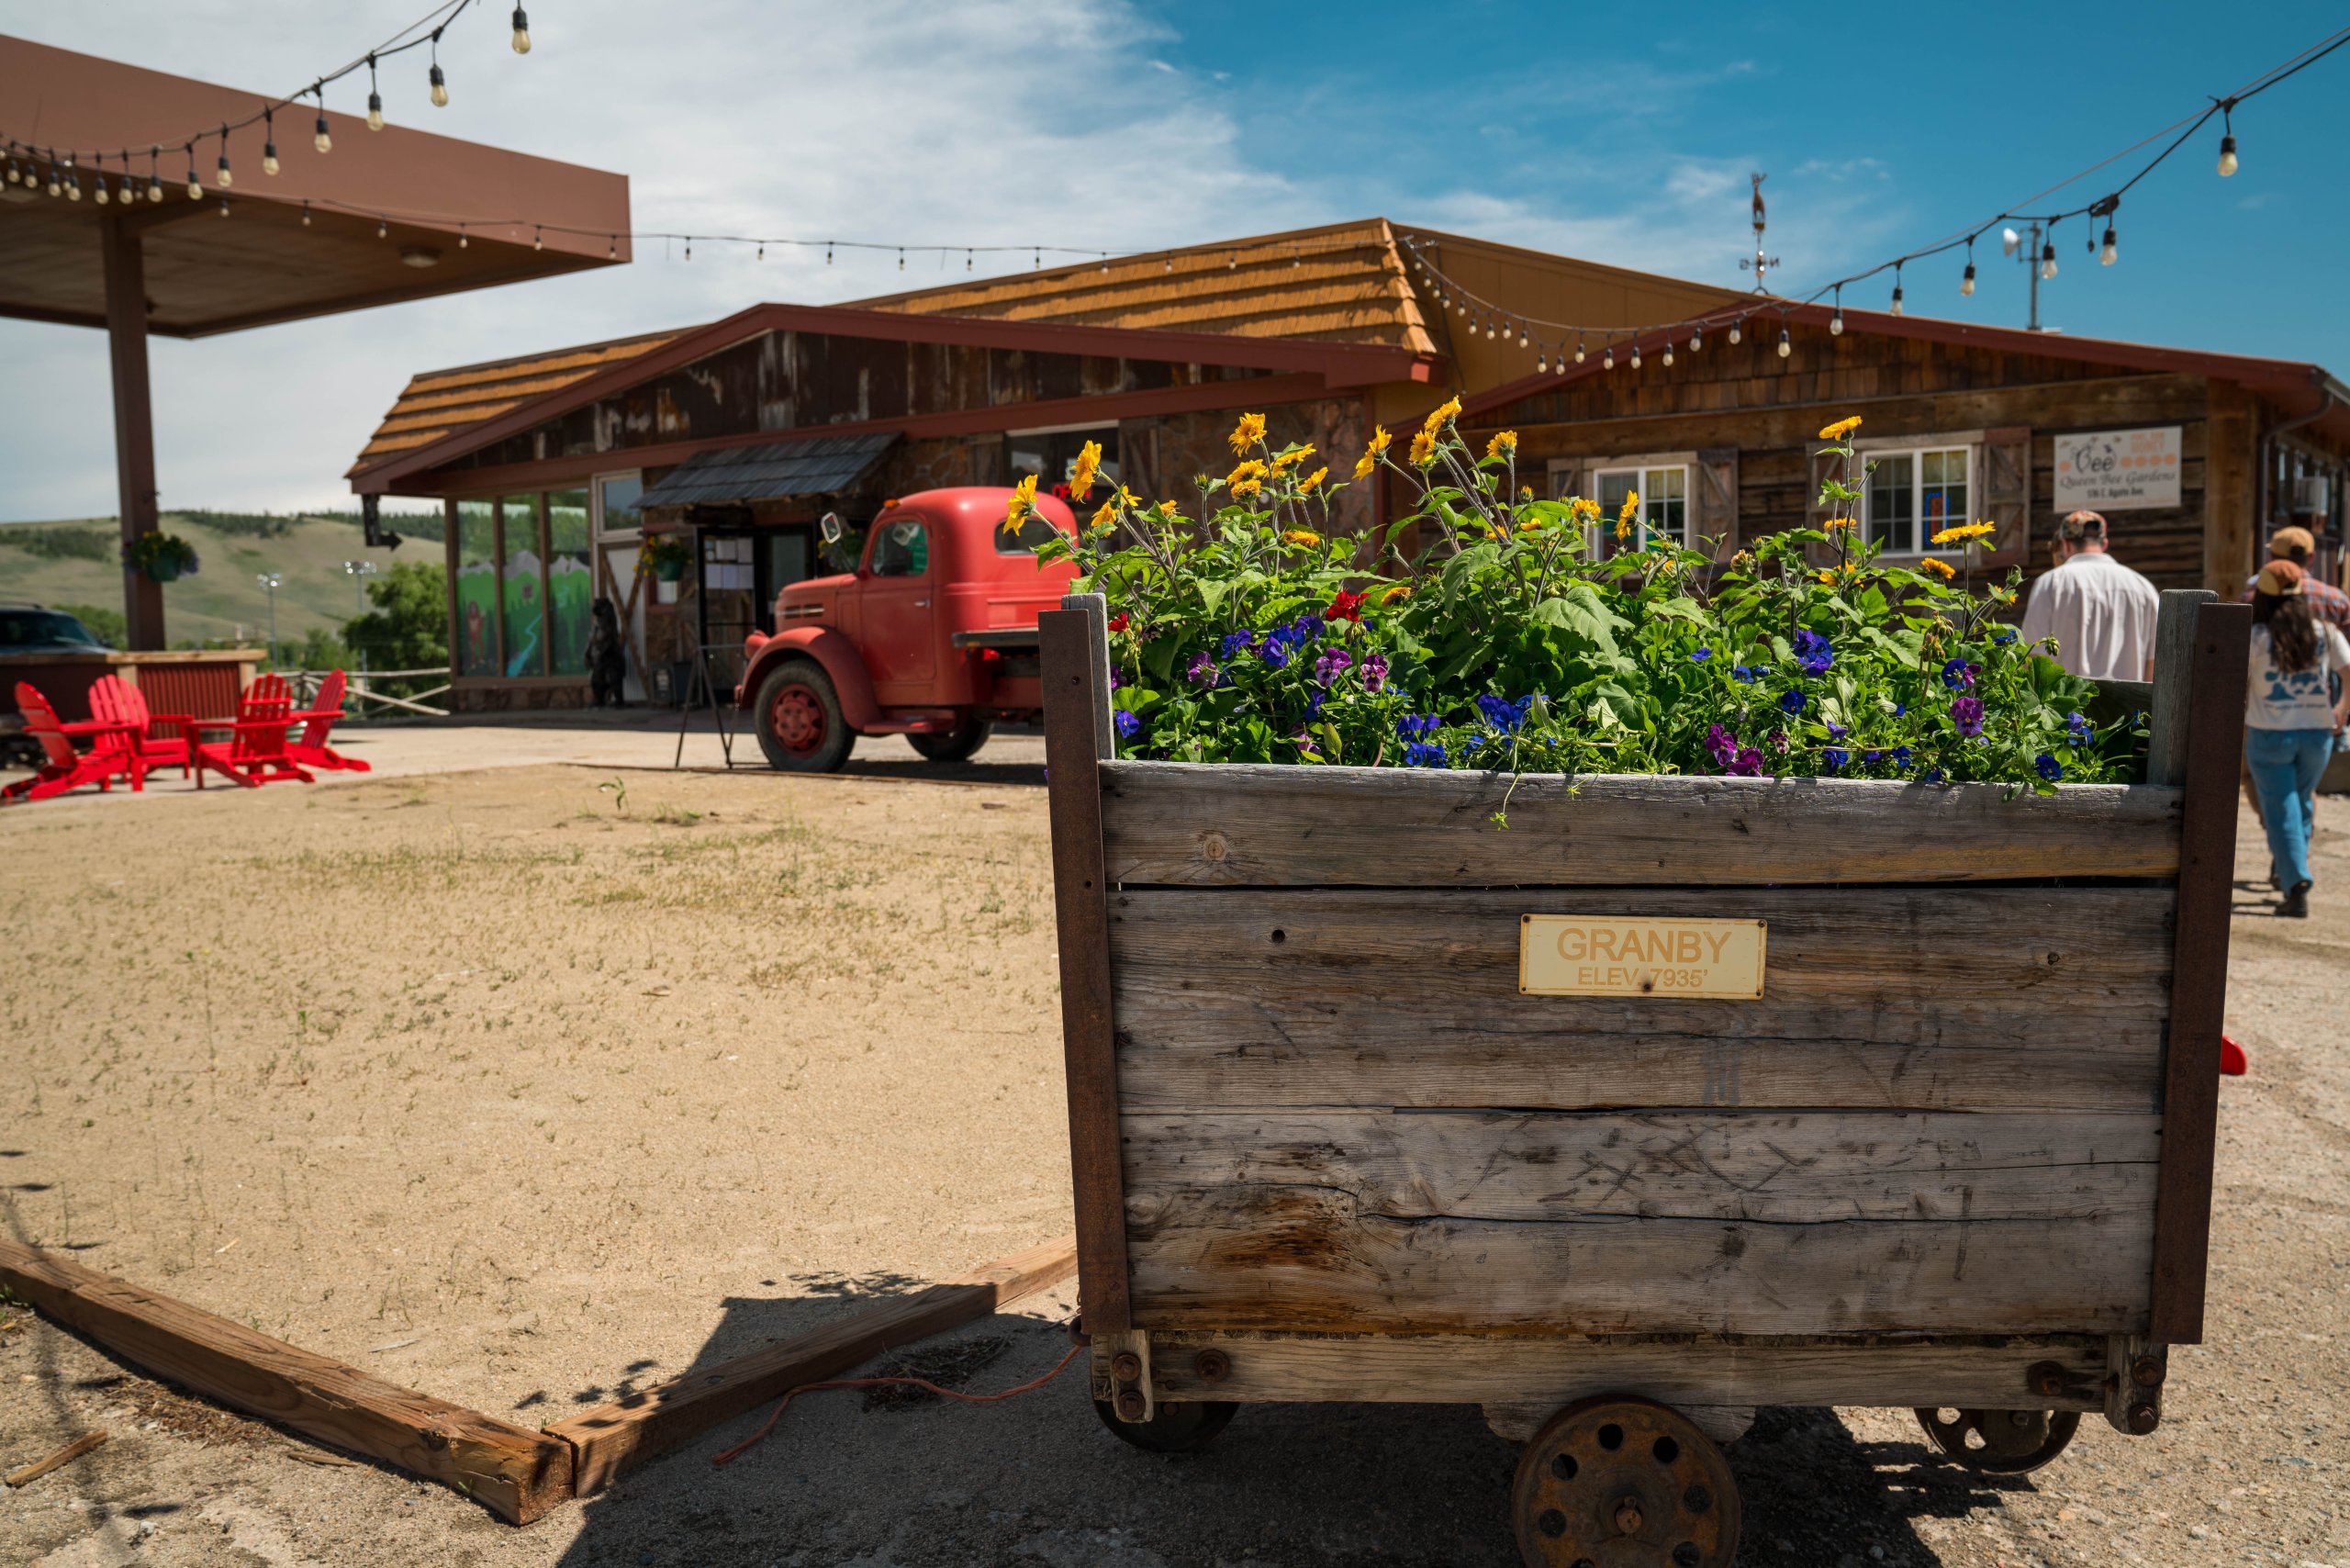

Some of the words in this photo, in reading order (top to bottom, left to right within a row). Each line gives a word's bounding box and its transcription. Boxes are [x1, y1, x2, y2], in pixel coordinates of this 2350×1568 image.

[2060, 476, 2097, 489] Queen
[2099, 473, 2121, 485] Bee
[2126, 469, 2176, 485] Gardens
[1557, 928, 1732, 964] GRANBY
